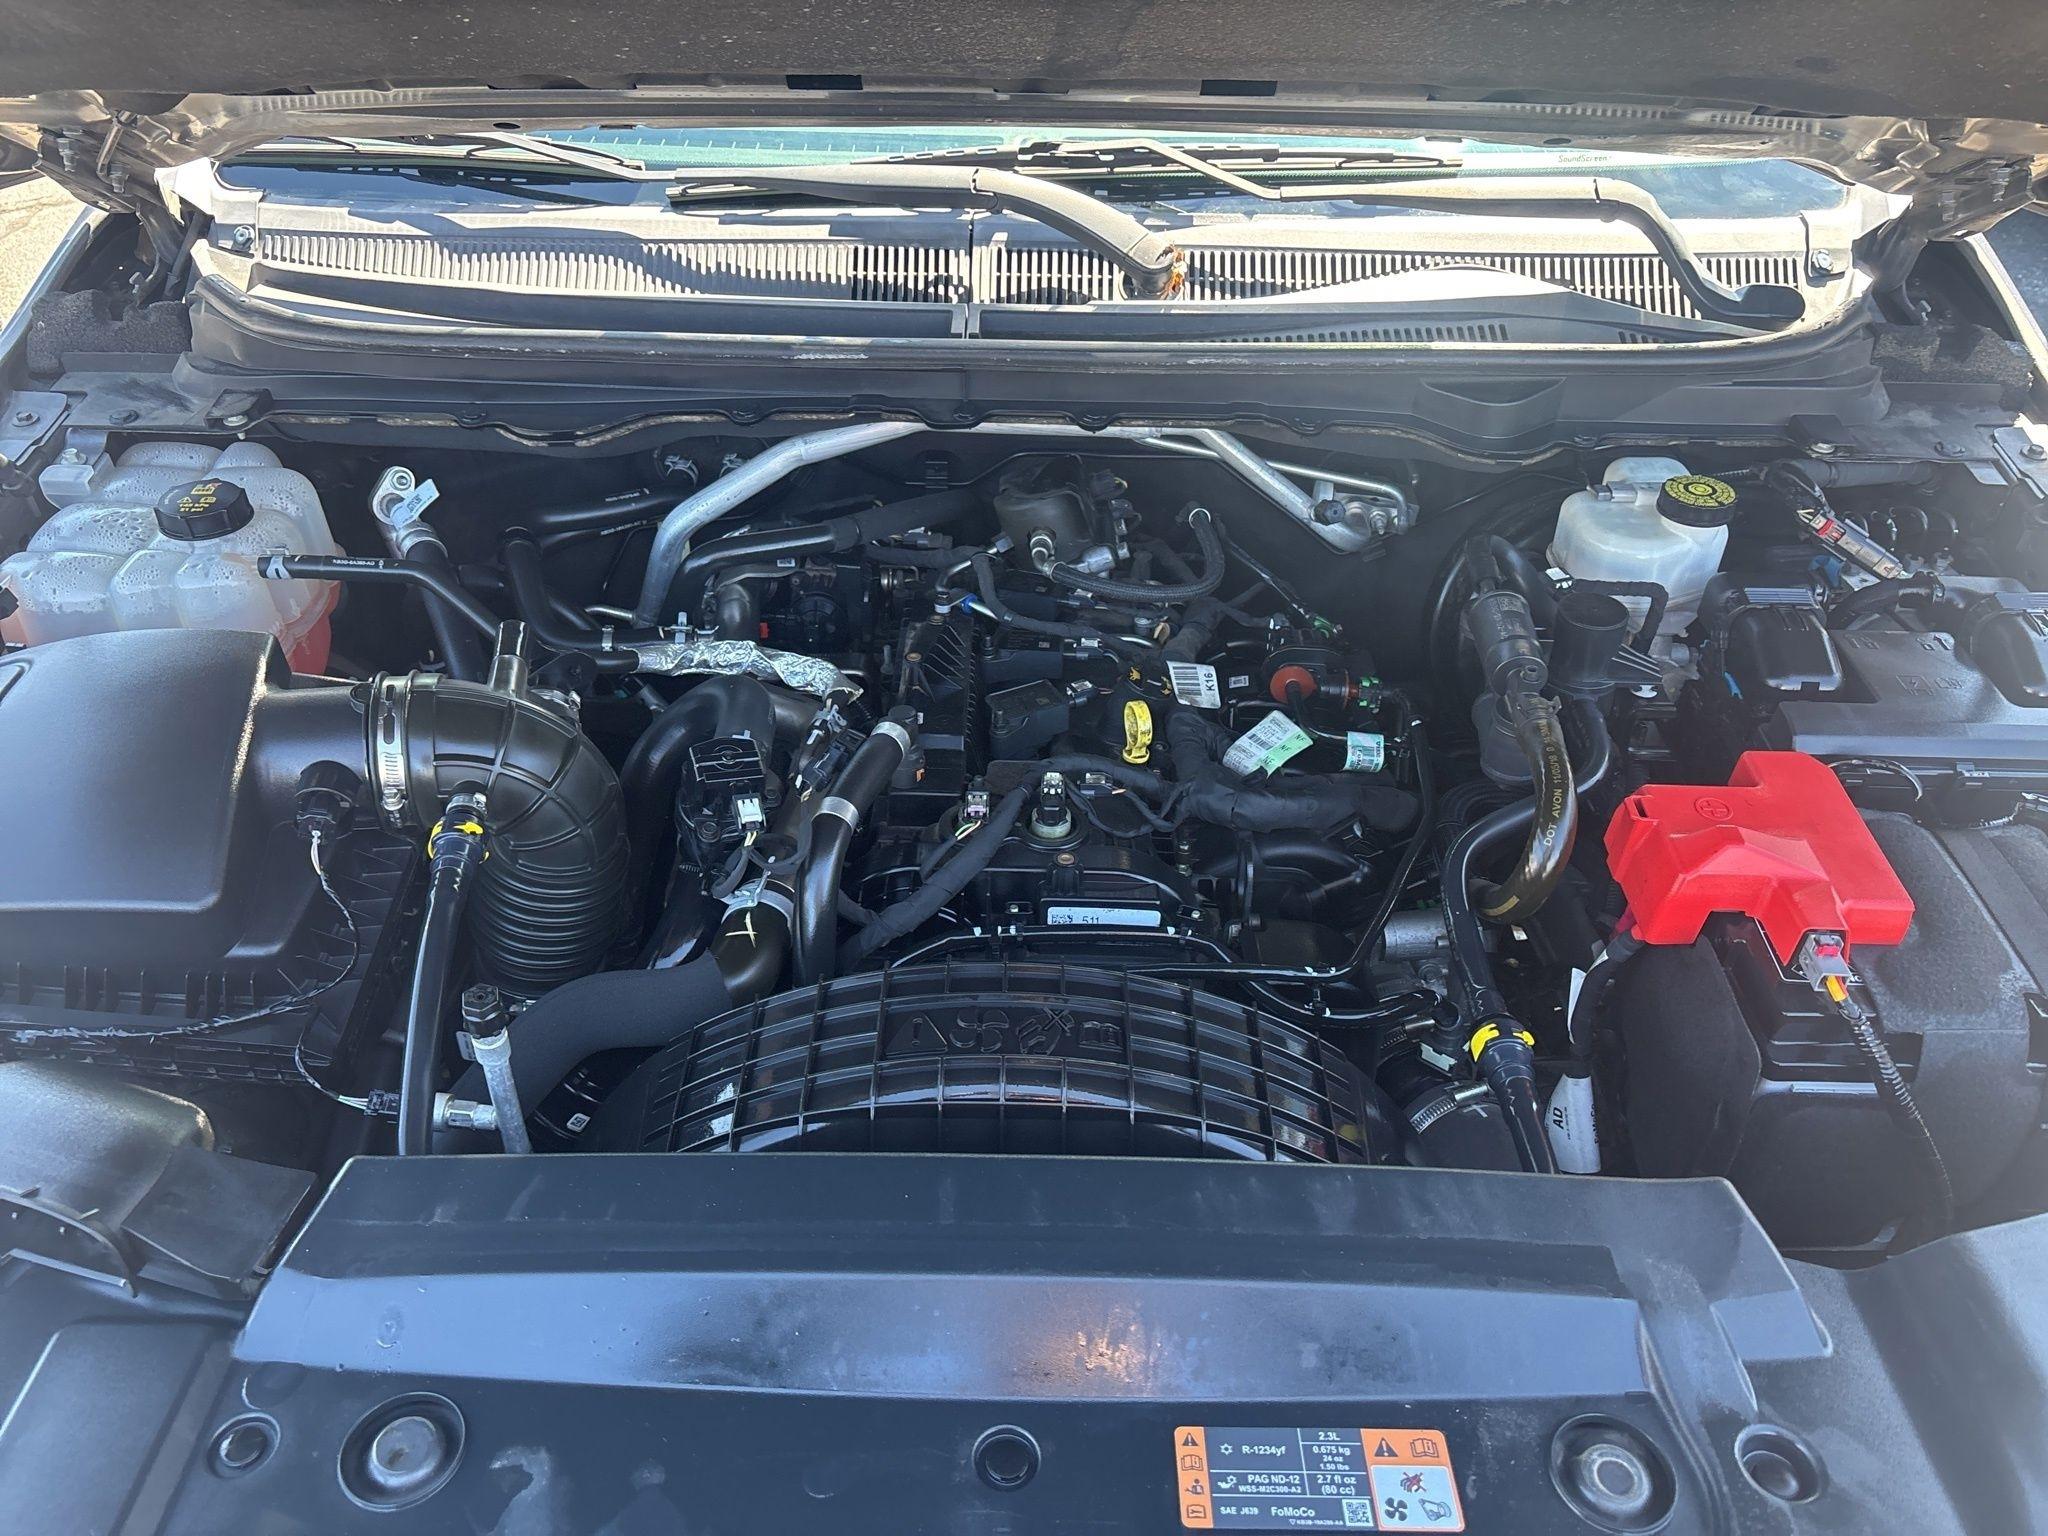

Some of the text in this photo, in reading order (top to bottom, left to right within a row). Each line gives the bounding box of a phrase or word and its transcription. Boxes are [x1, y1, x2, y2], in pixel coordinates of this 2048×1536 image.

[1203, 672, 1215, 691] K16
[1544, 822, 1557, 846] DOT
[1552, 788, 1562, 818] AVON
[1552, 1106, 1564, 1130] AD
[1318, 1431, 1340, 1440] 2.3L
[1241, 1445, 1286, 1456] R-1234yf
[1312, 1445, 1351, 1456] 0.675 kg
[1247, 1474, 1300, 1484] PAG ND-12
[1316, 1474, 1357, 1484] 2.7 fl oz
[1339, 1485, 1355, 1496] cc)
[1219, 1506, 1238, 1515] SAE
[1270, 1506, 1316, 1517] FoMoCo
